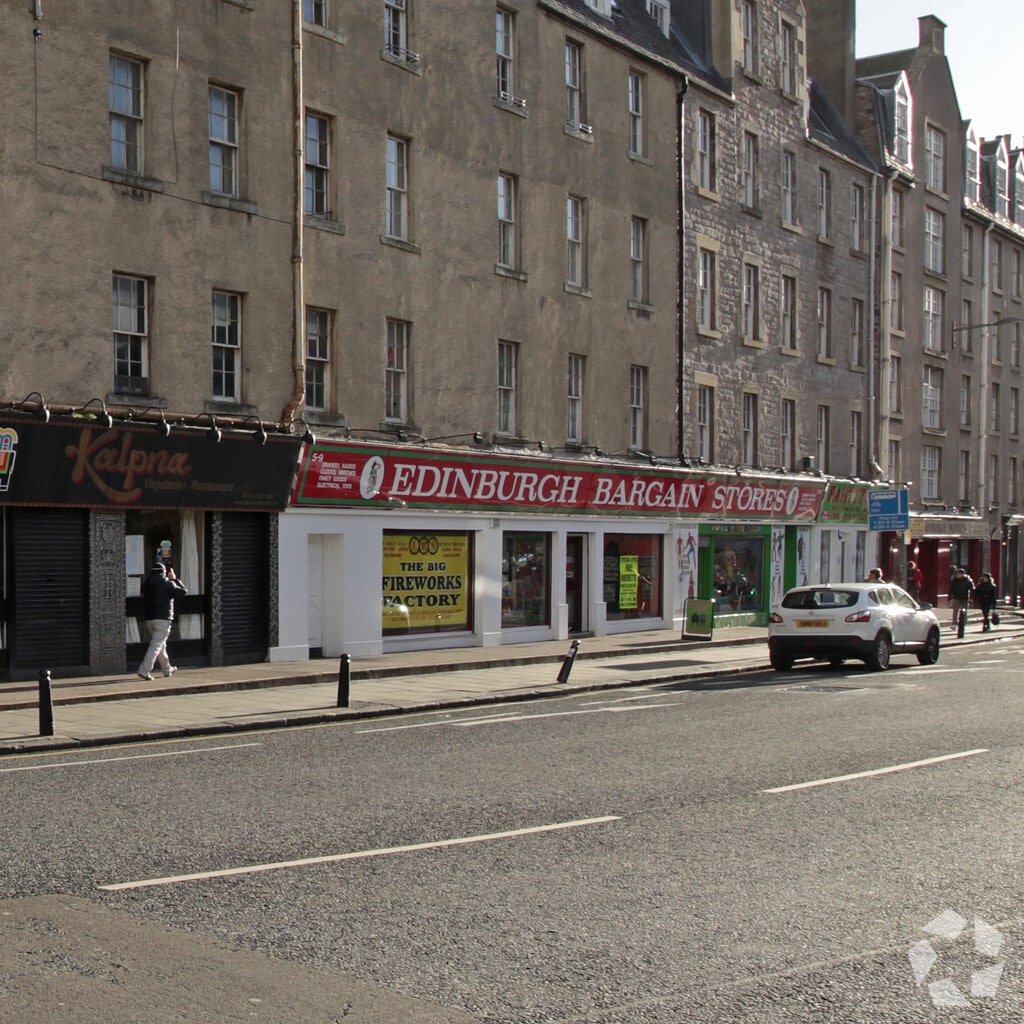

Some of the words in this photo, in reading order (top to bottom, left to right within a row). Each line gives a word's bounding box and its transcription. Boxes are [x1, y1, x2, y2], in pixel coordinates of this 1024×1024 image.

[64, 426, 193, 505] Kalpna
[388, 462, 583, 504] EDINBURGH
[592, 477, 705, 509] BARGAIN
[710, 484, 788, 516] STORES
[400, 562, 424, 572] THE
[427, 562, 446, 572] BIG
[382, 575, 462, 591] FIREWORKS
[383, 593, 462, 608] FACTORY
